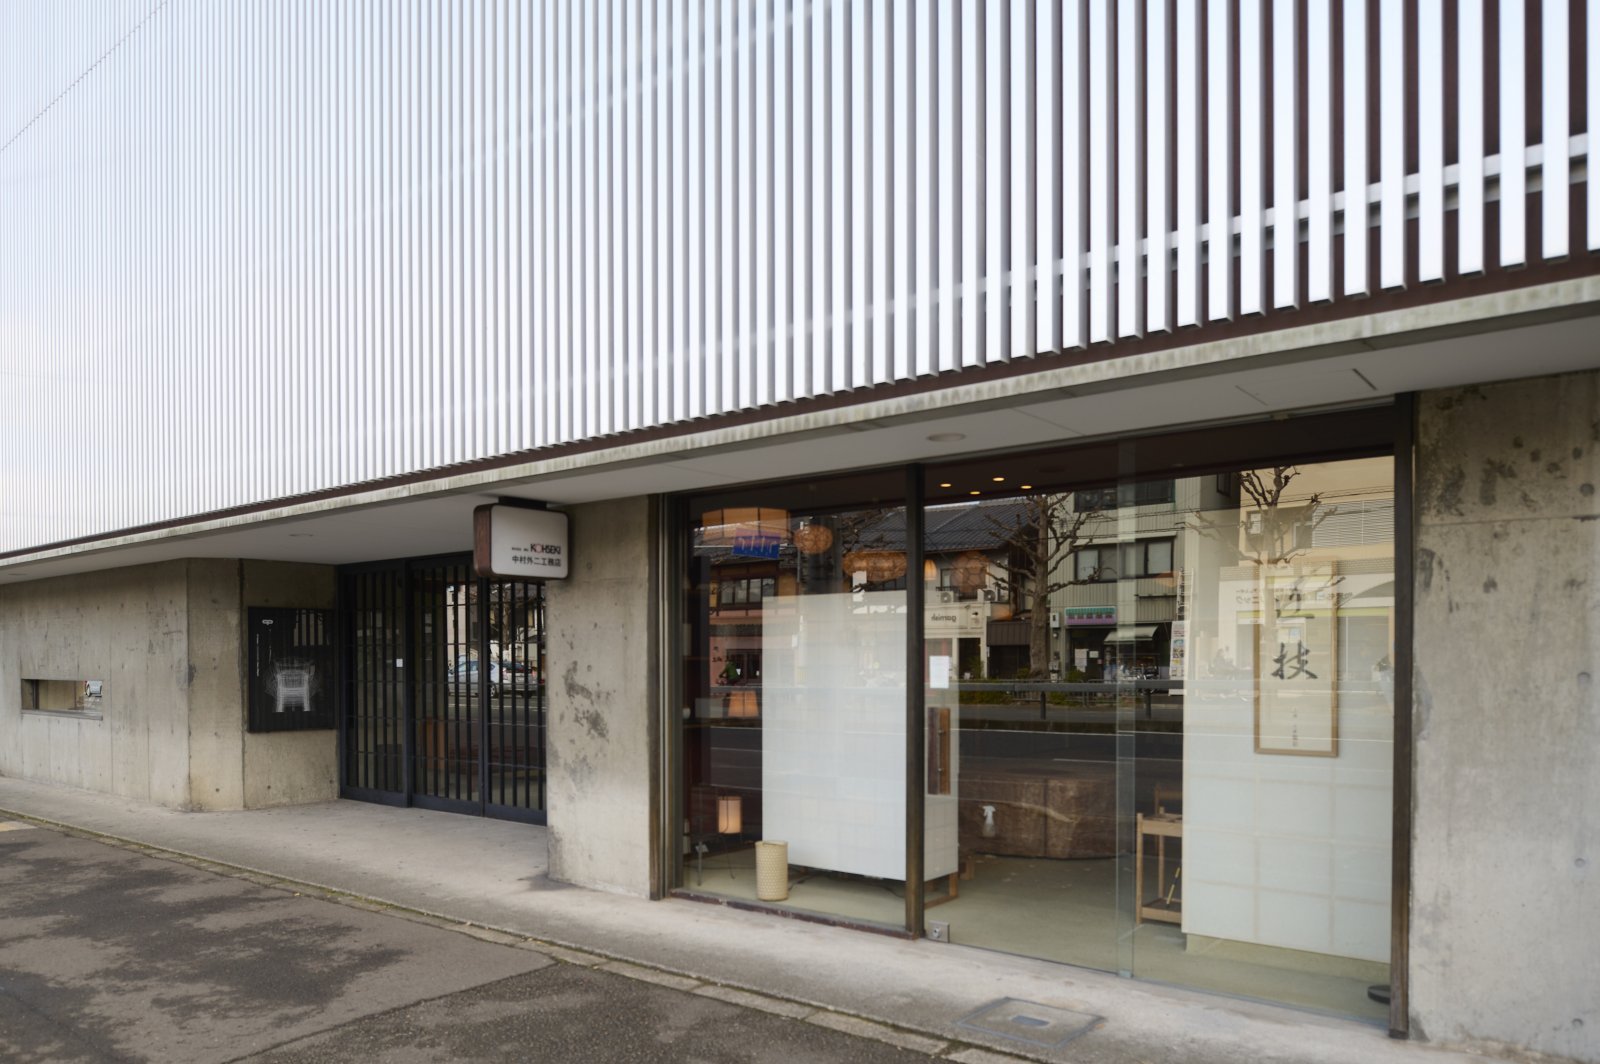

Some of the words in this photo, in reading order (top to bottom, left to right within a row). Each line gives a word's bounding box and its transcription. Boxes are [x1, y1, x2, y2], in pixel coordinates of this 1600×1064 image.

[511, 555, 561, 567] 中村外二工務店
